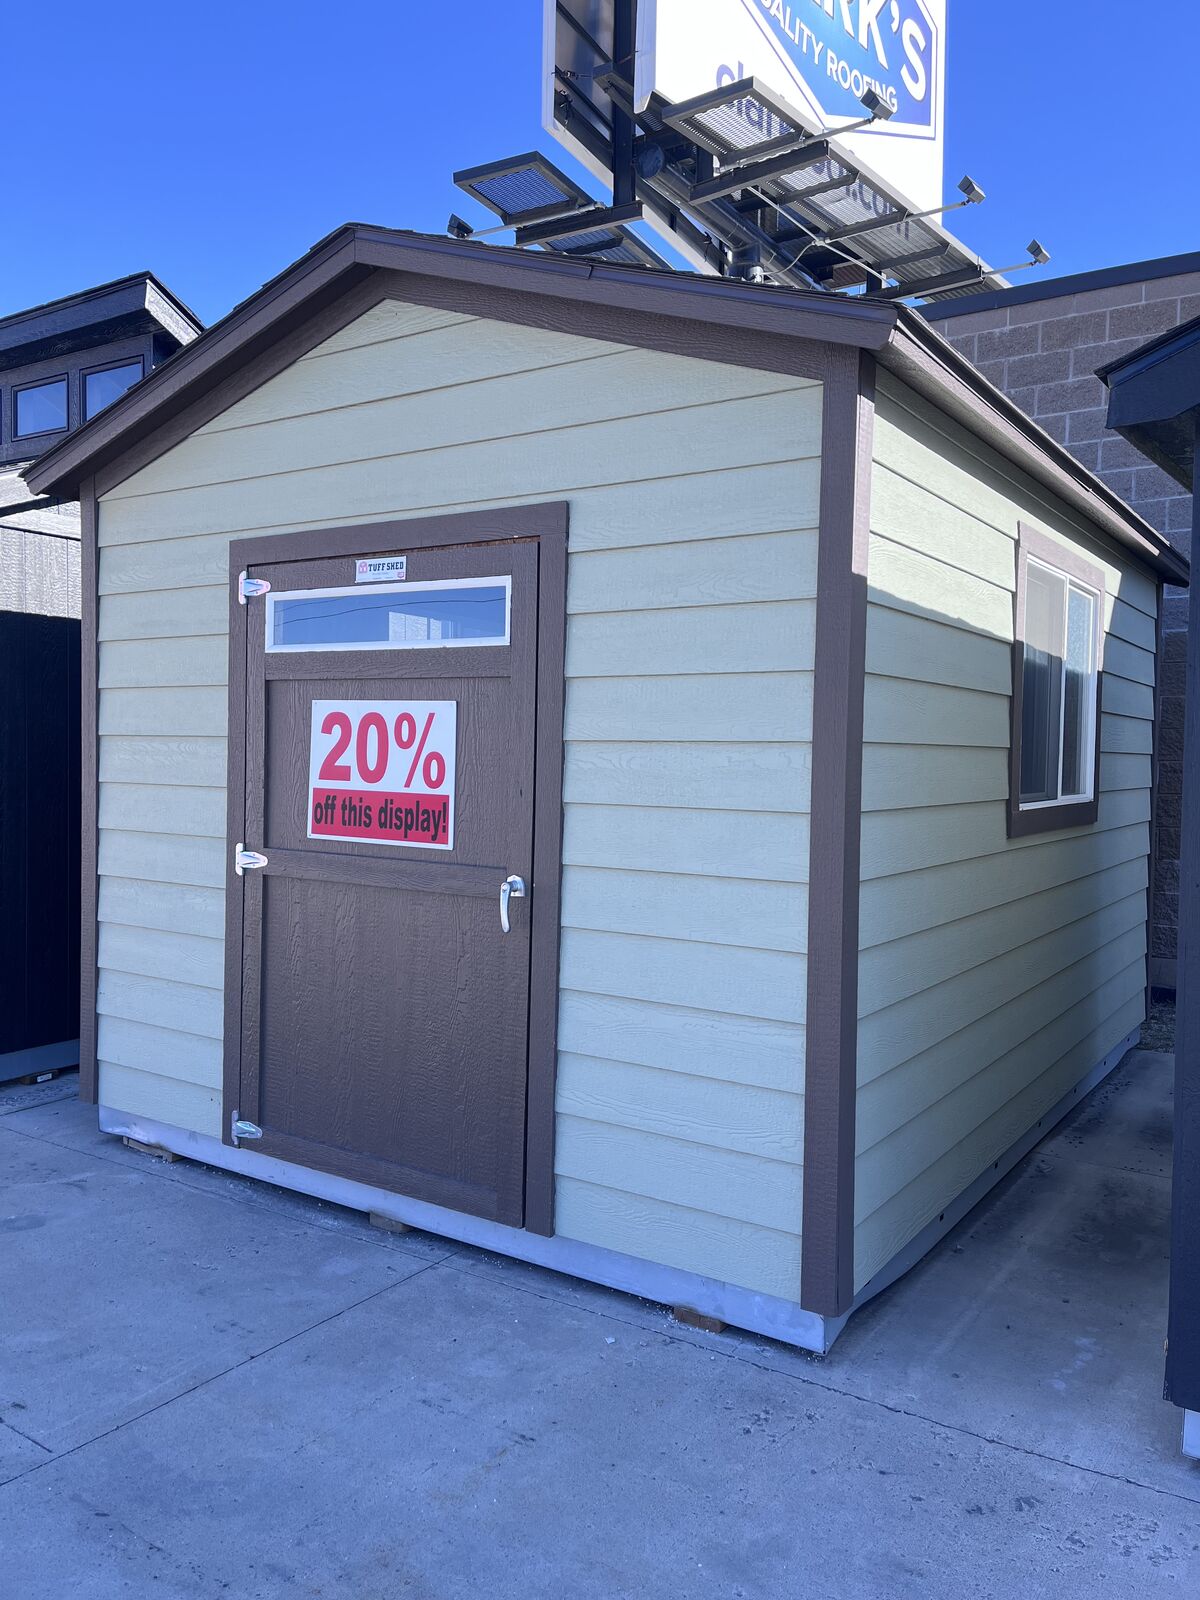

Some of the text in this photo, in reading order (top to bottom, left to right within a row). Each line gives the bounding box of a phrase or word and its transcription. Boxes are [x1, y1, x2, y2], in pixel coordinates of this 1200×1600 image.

[368, 562, 403, 571] TUFF SHED
[318, 711, 446, 789] 20%
[314, 795, 447, 841] off this display!
